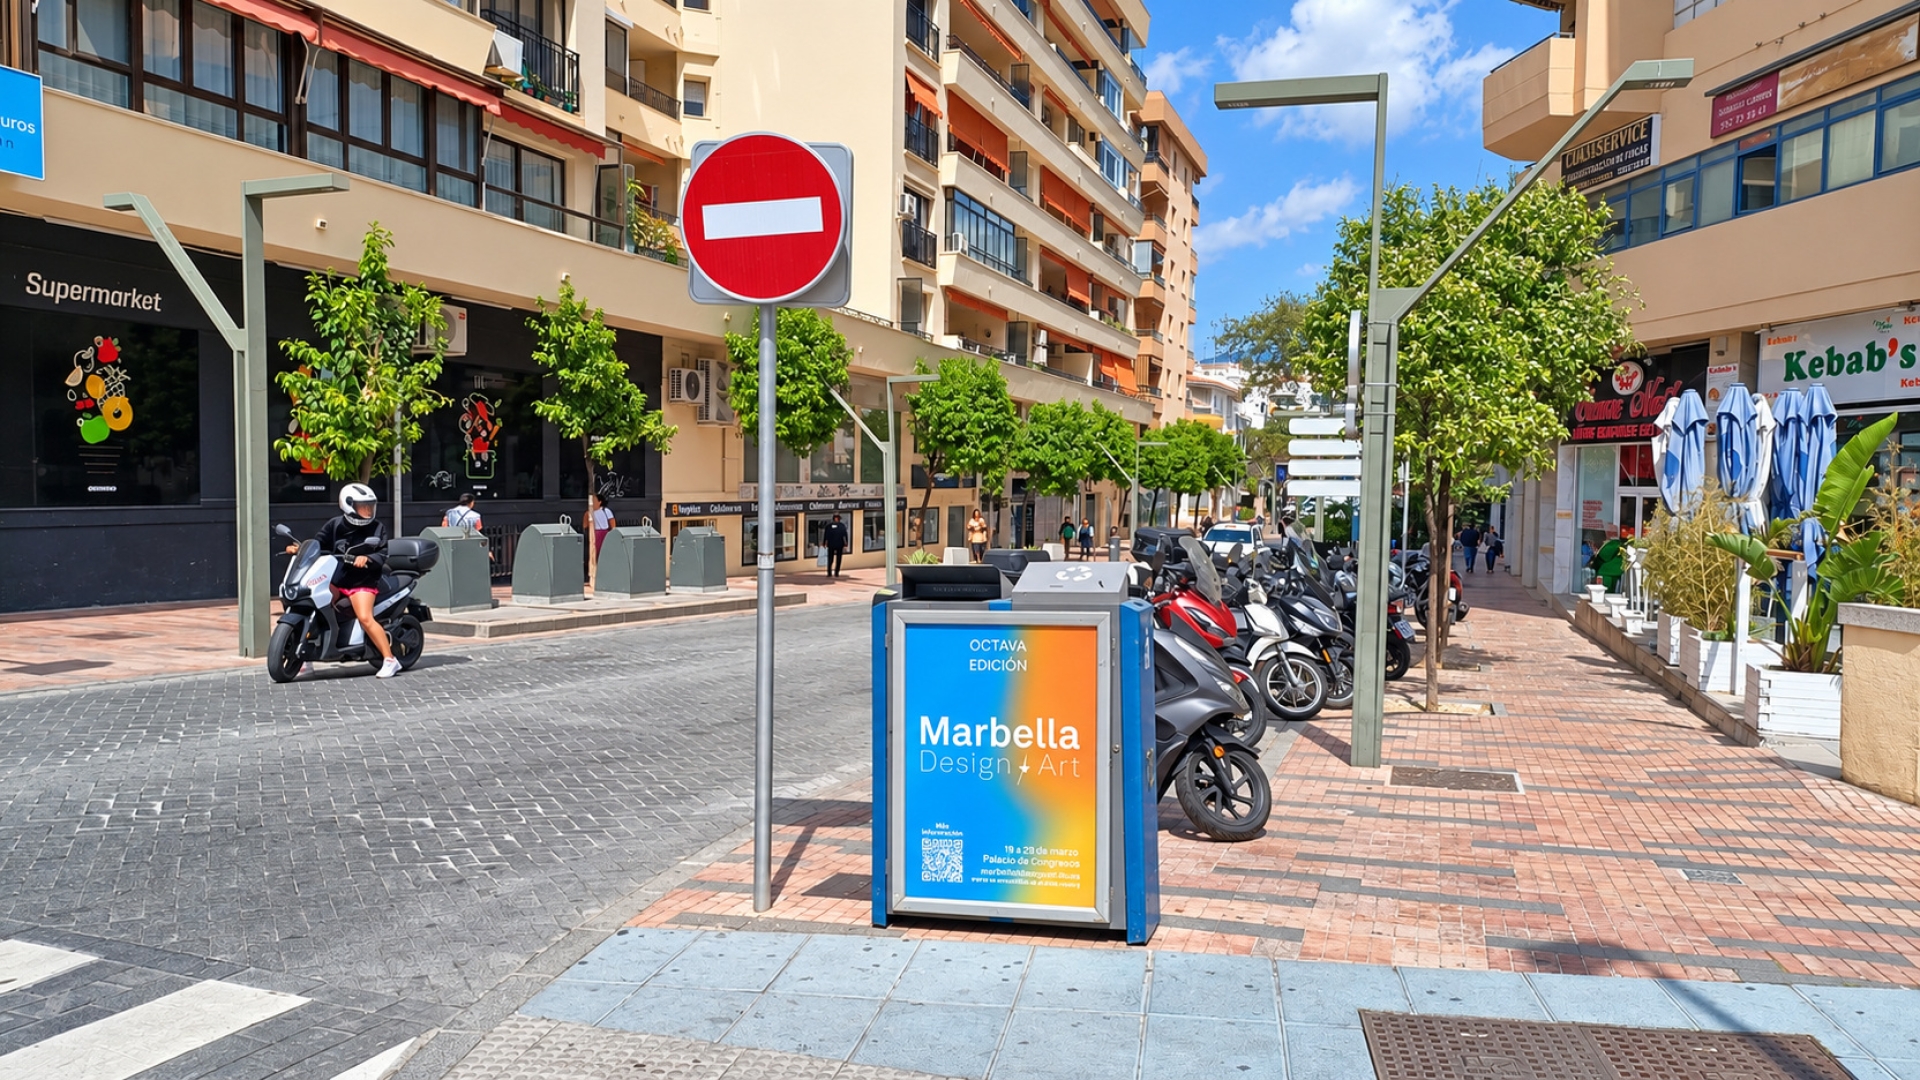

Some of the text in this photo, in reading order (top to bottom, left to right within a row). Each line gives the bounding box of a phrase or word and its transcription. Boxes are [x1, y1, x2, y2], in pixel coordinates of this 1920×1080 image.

[25, 271, 162, 312] Supermarket
[1783, 337, 1917, 382] Kebab's
[969, 638, 1027, 652] OCTAVA
[969, 656, 1027, 672] EDICIÓN
[919, 715, 1081, 750] Marbella
[920, 749, 1080, 781] Design Art
[983, 854, 1016, 865] Palacio
[1017, 857, 1029, 865] de
[1036, 846, 1048, 855] de
[1050, 848, 1079, 857] marzo
